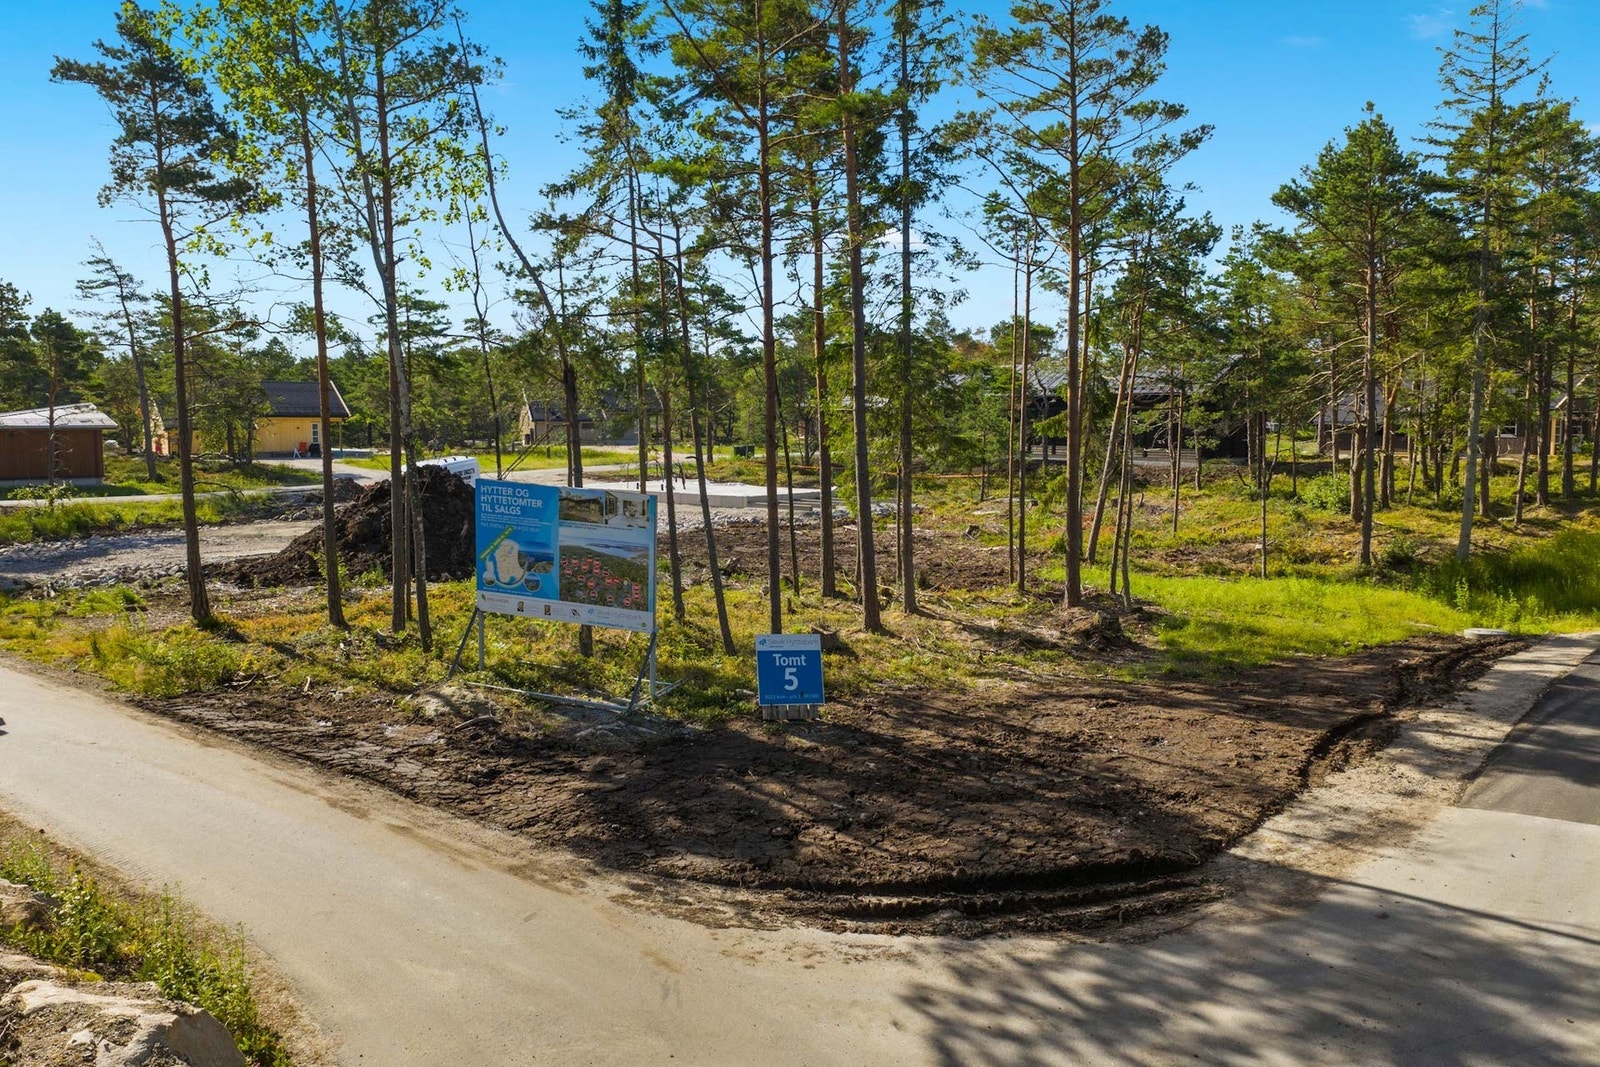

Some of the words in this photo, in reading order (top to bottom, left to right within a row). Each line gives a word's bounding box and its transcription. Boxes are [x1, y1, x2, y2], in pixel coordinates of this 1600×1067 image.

[480, 485, 513, 496] HYTTER
[515, 488, 529, 498] OG
[480, 494, 543, 508] HYTTETOMTER
[480, 503, 493, 512] TIL
[494, 504, 521, 515] SALGS
[772, 653, 807, 666] Tomt
[784, 667, 799, 691] 5
